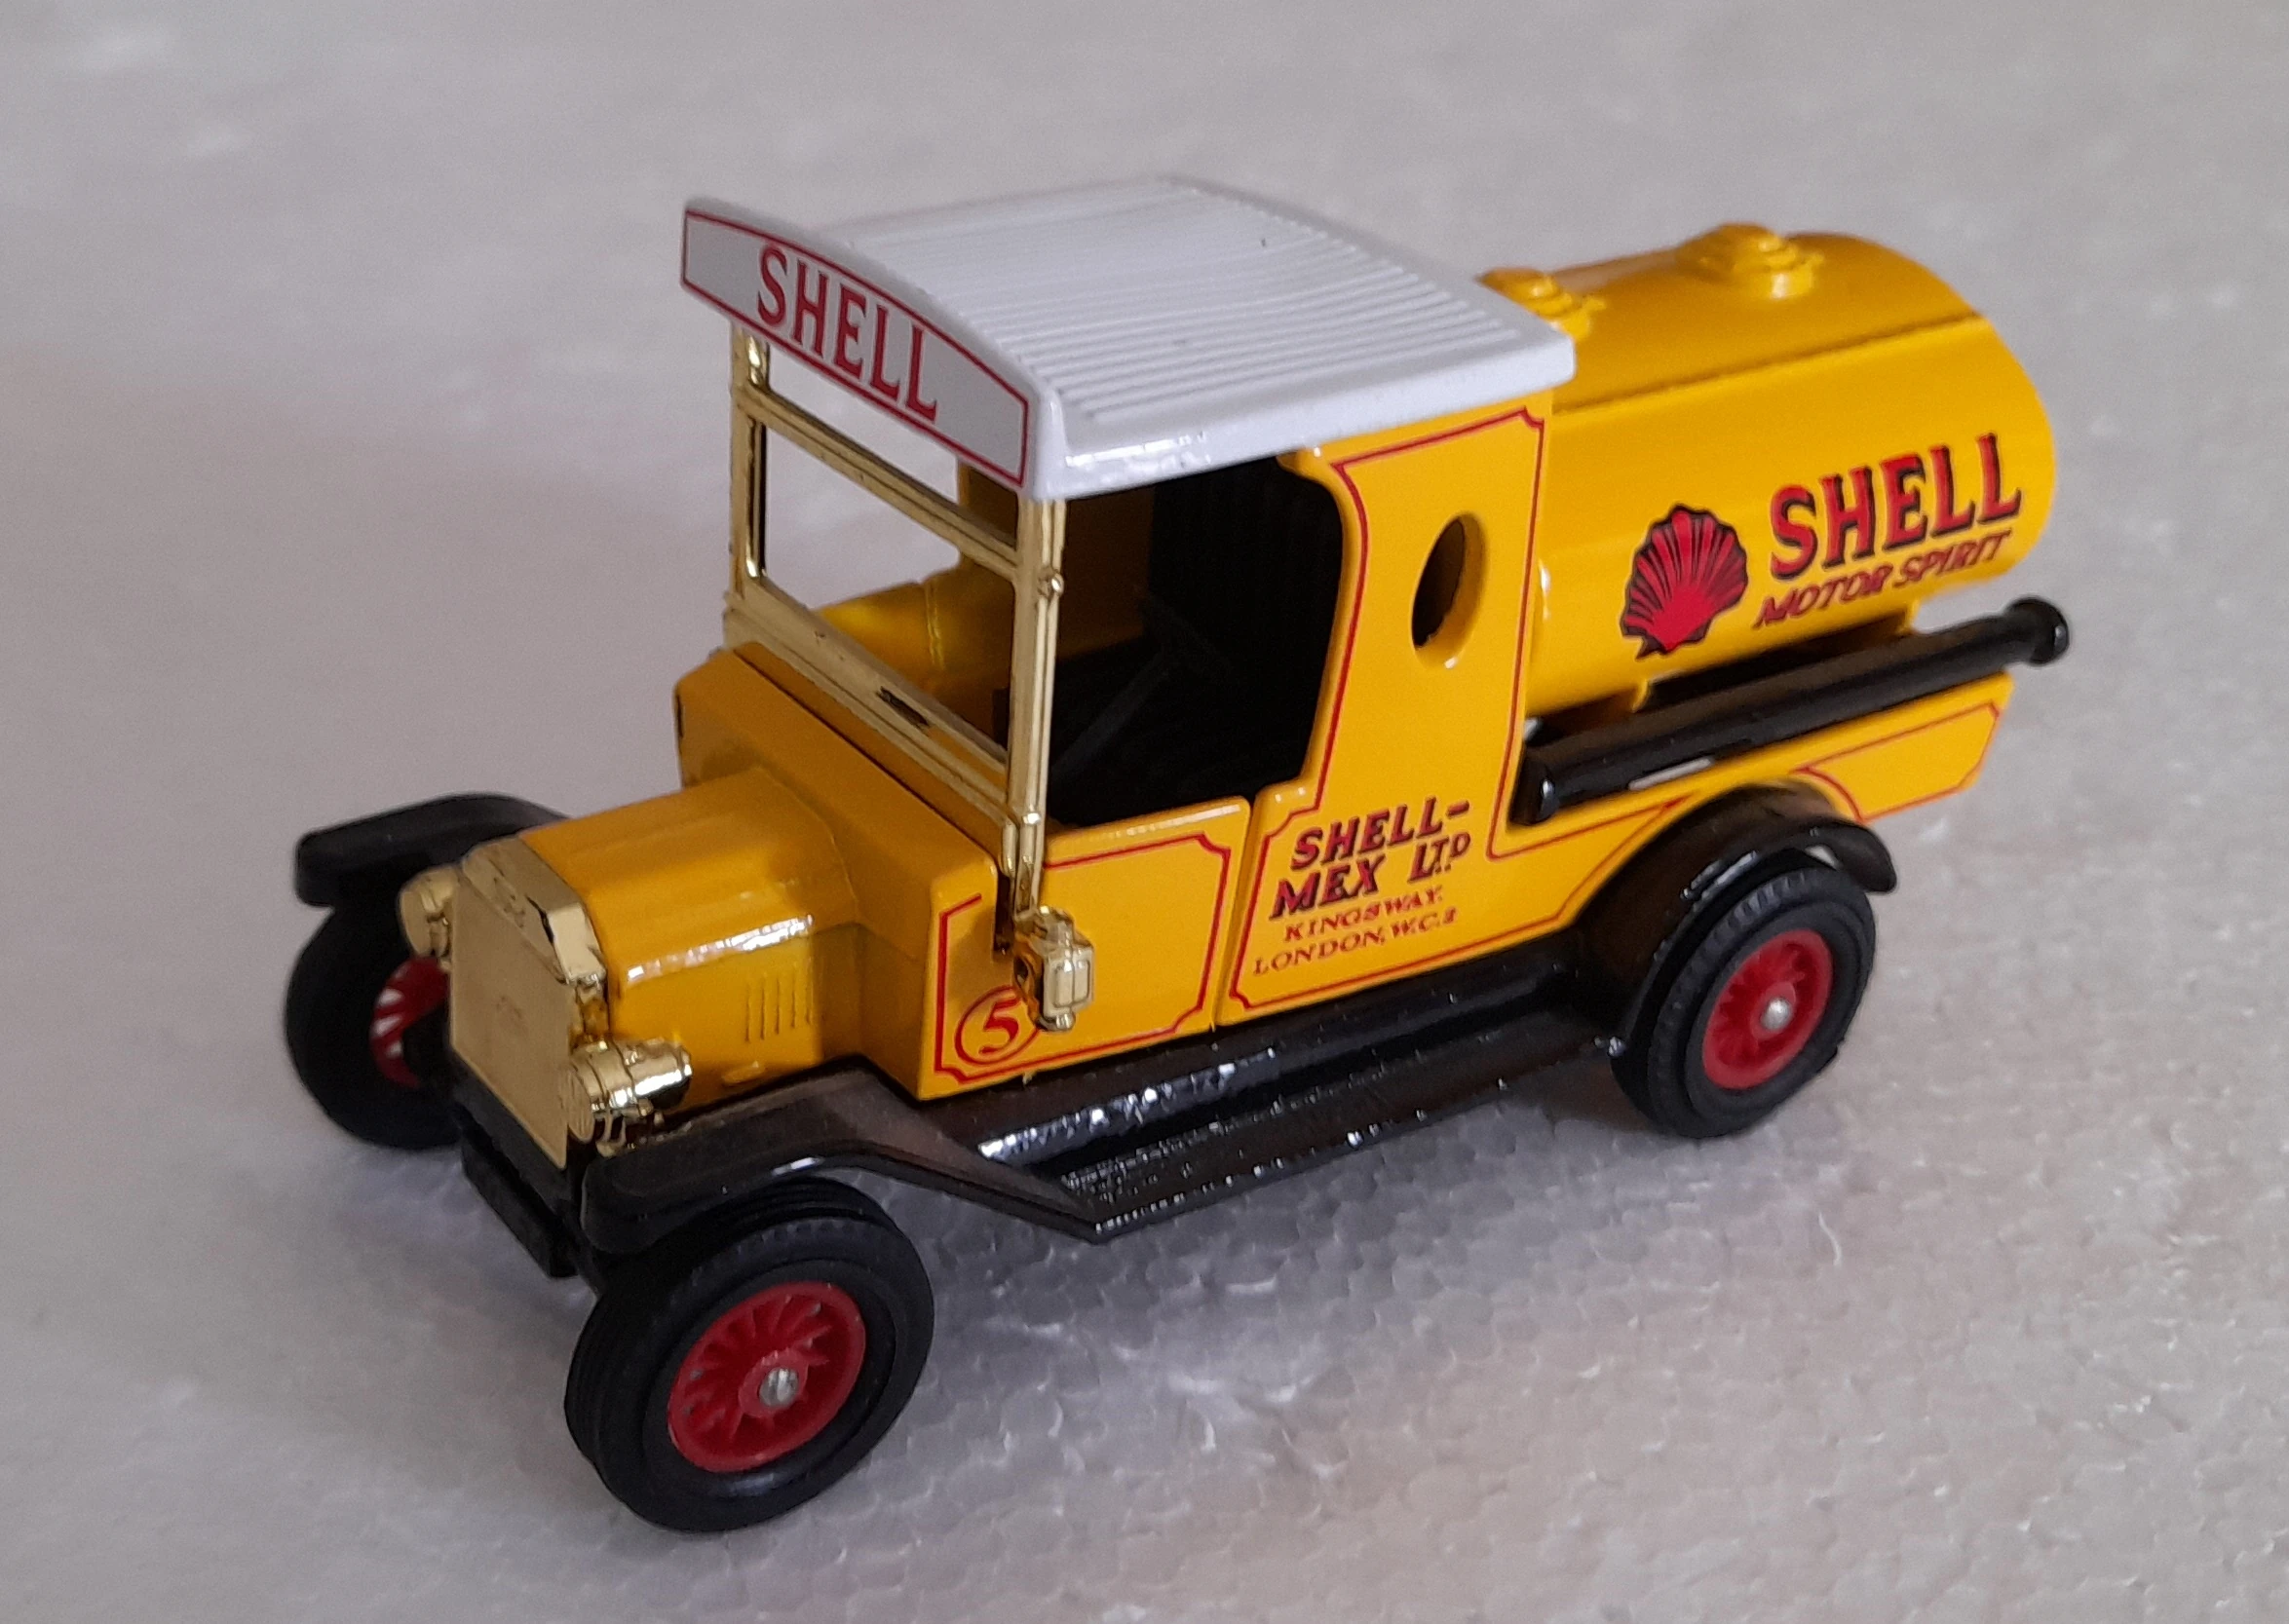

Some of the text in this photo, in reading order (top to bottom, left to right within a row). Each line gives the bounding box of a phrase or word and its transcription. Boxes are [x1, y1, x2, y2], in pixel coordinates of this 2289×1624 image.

[757, 244, 937, 422] SHELL
[1770, 433, 2022, 580] SHELL
[1754, 530, 2011, 629] MOTOR SPIRIT
[1290, 796, 1470, 870] SHELL-
[1269, 853, 1386, 921] MEX
[978, 998, 1021, 1055] 5
